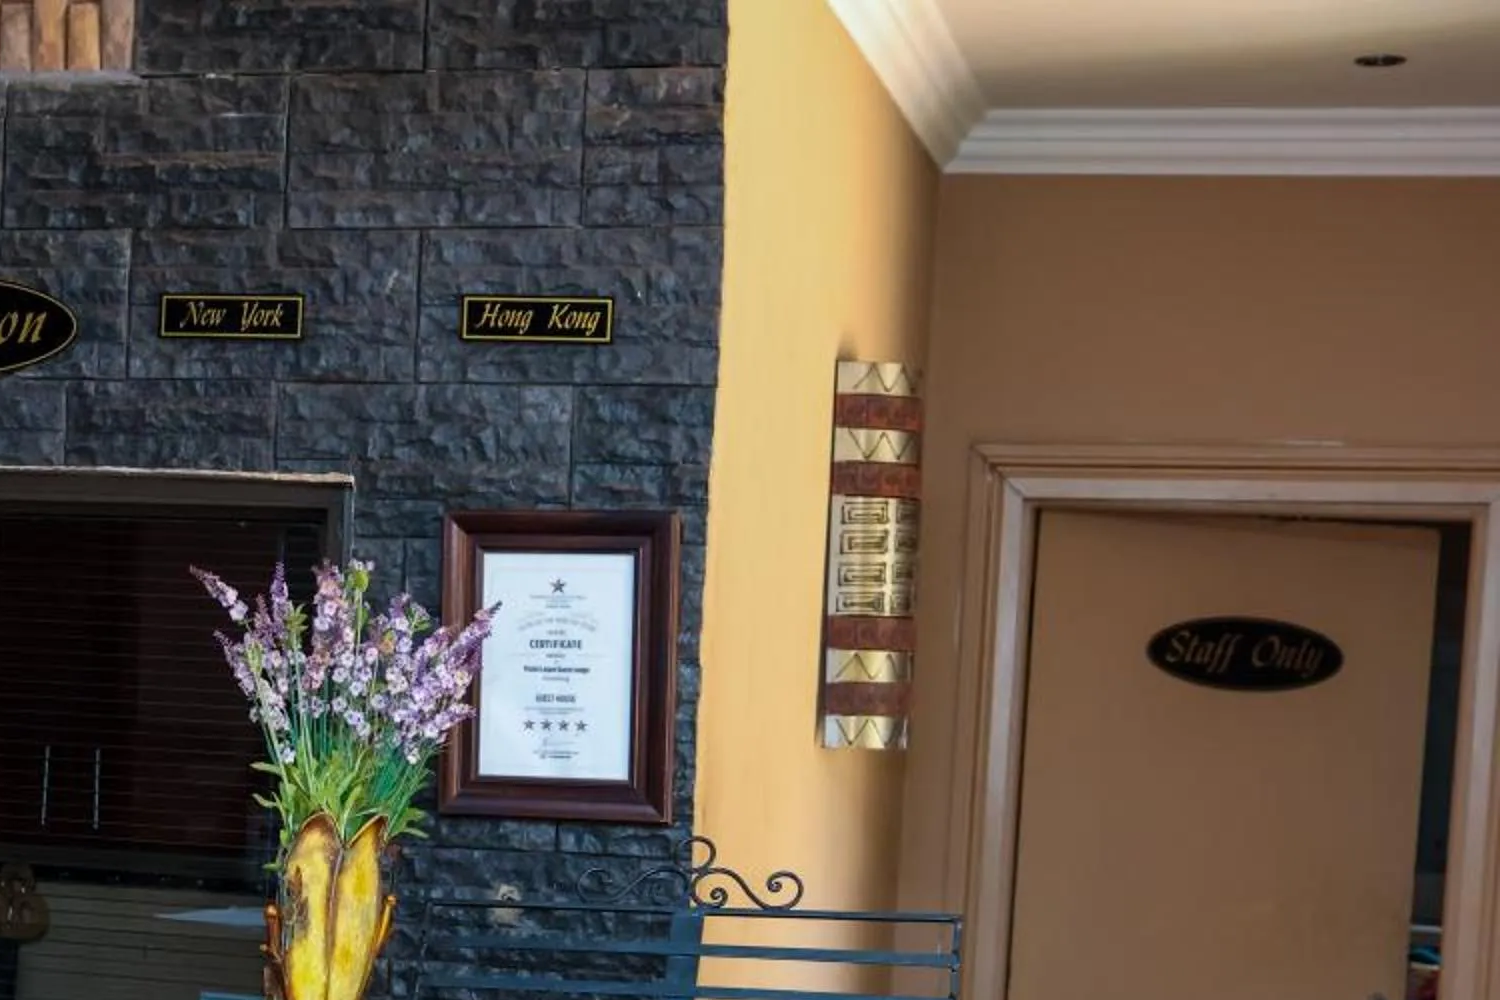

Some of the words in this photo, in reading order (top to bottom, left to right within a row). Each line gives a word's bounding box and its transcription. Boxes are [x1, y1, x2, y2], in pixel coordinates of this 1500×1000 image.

[180, 301, 225, 329] New
[240, 302, 285, 332] York
[476, 303, 533, 334] Hong
[547, 303, 601, 335] Kong
[529, 638, 583, 651] CERTIFICATE
[1165, 630, 1244, 673] Staff
[1251, 635, 1325, 678] Only
